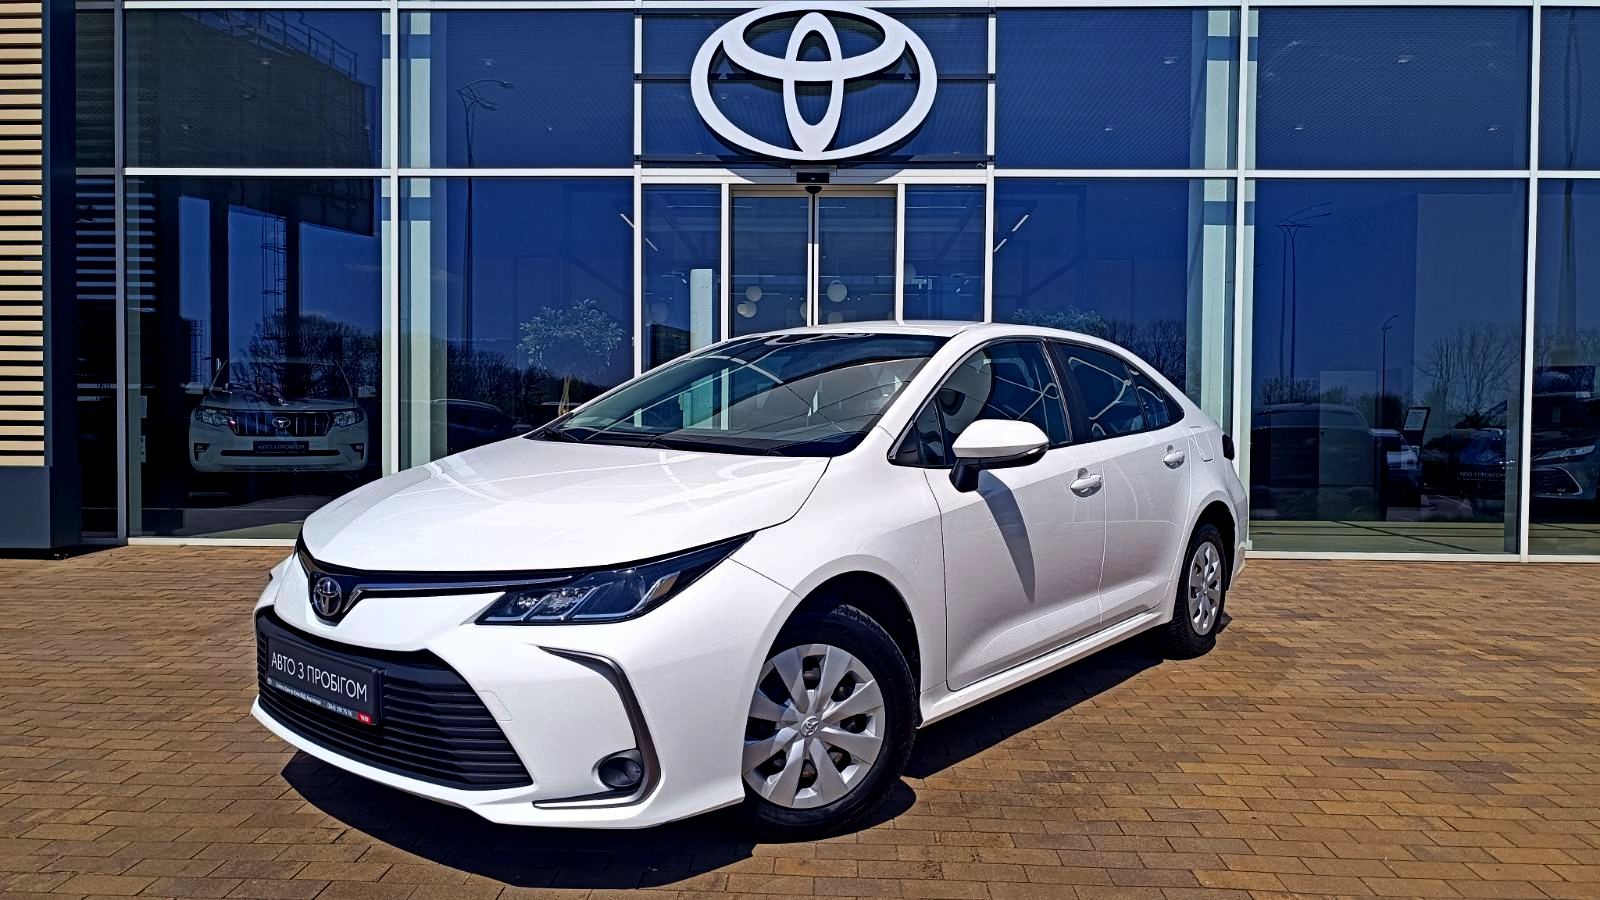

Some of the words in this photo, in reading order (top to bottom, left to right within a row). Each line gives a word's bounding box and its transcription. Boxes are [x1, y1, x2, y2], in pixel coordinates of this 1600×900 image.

[271, 652, 296, 675] АВТО
[298, 662, 304, 679] З
[307, 665, 367, 702] ПРОБІГОМ
